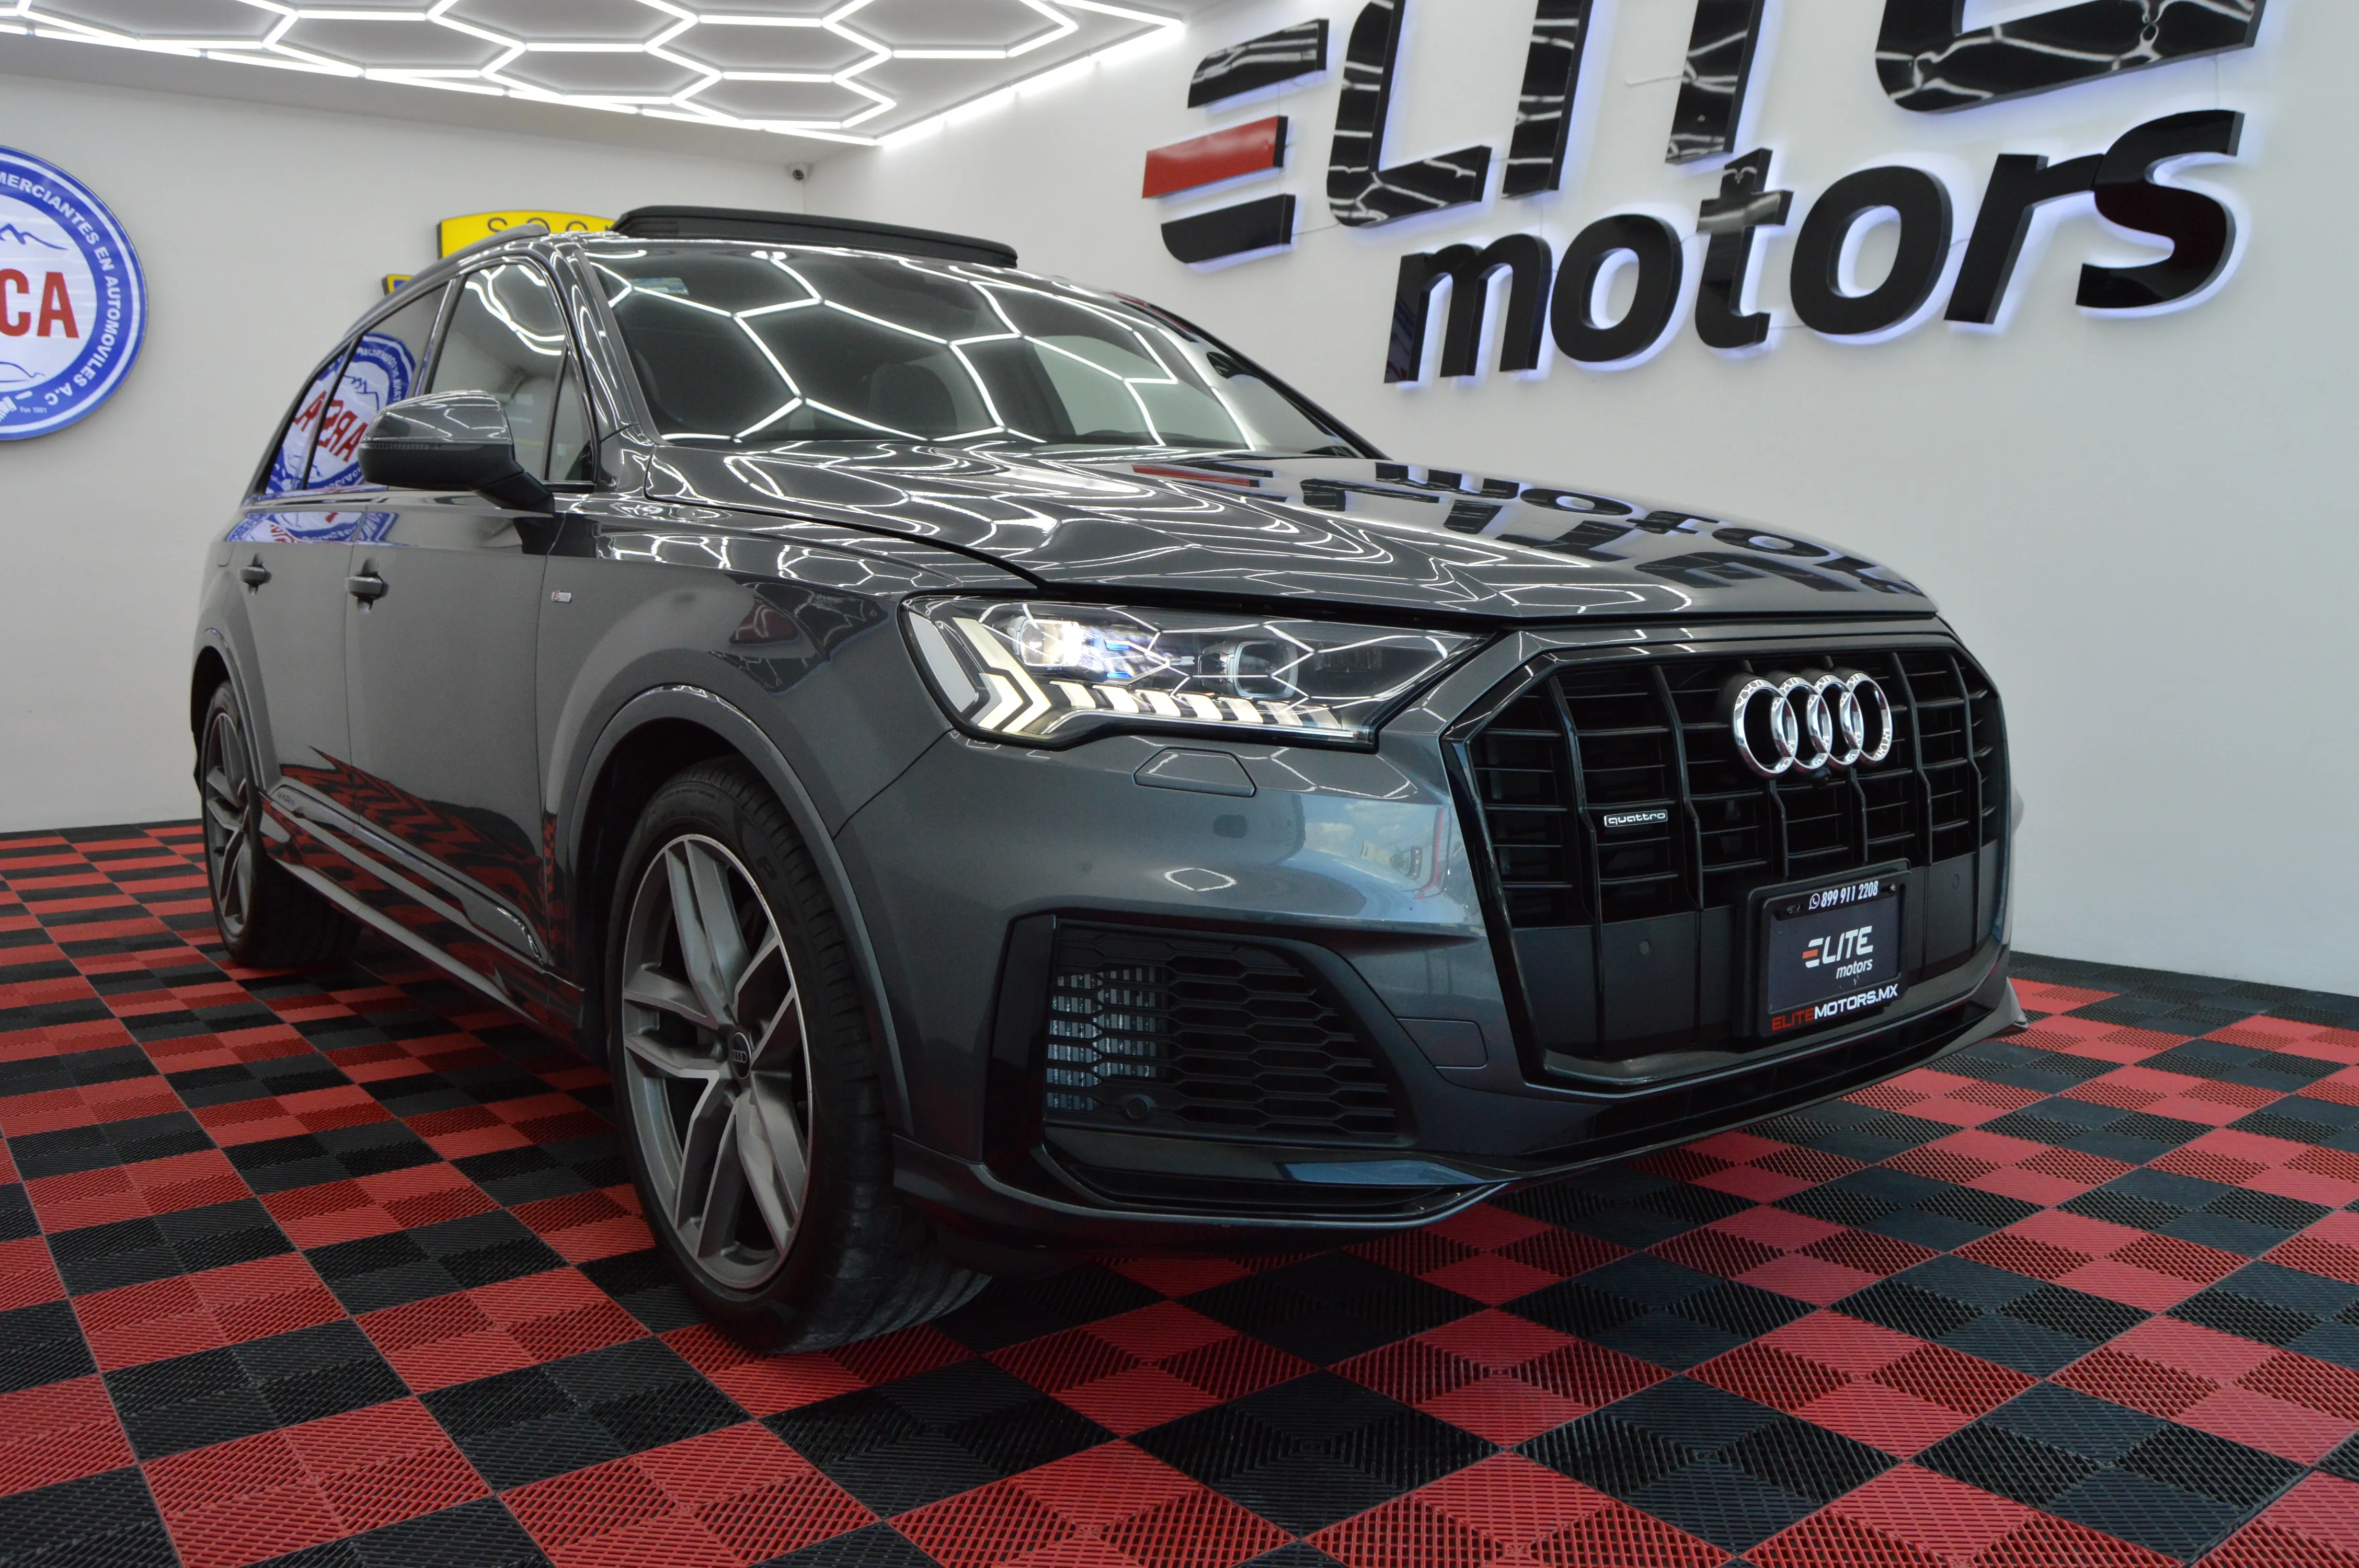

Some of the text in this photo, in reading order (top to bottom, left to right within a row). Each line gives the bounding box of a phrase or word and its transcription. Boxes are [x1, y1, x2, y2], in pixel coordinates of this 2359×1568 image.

[94, 246, 115, 271] EN
[1384, 109, 2245, 384] motors
[73, 276, 121, 387] AUTOMOVILES
[1608, 812, 1666, 825] quattro
[1820, 880, 1879, 908] 899 911 2208
[1802, 925, 1874, 969] ELITE
[1836, 959, 1873, 979] motors
[1772, 983, 1898, 1031] ELITEMOTORS.MX
